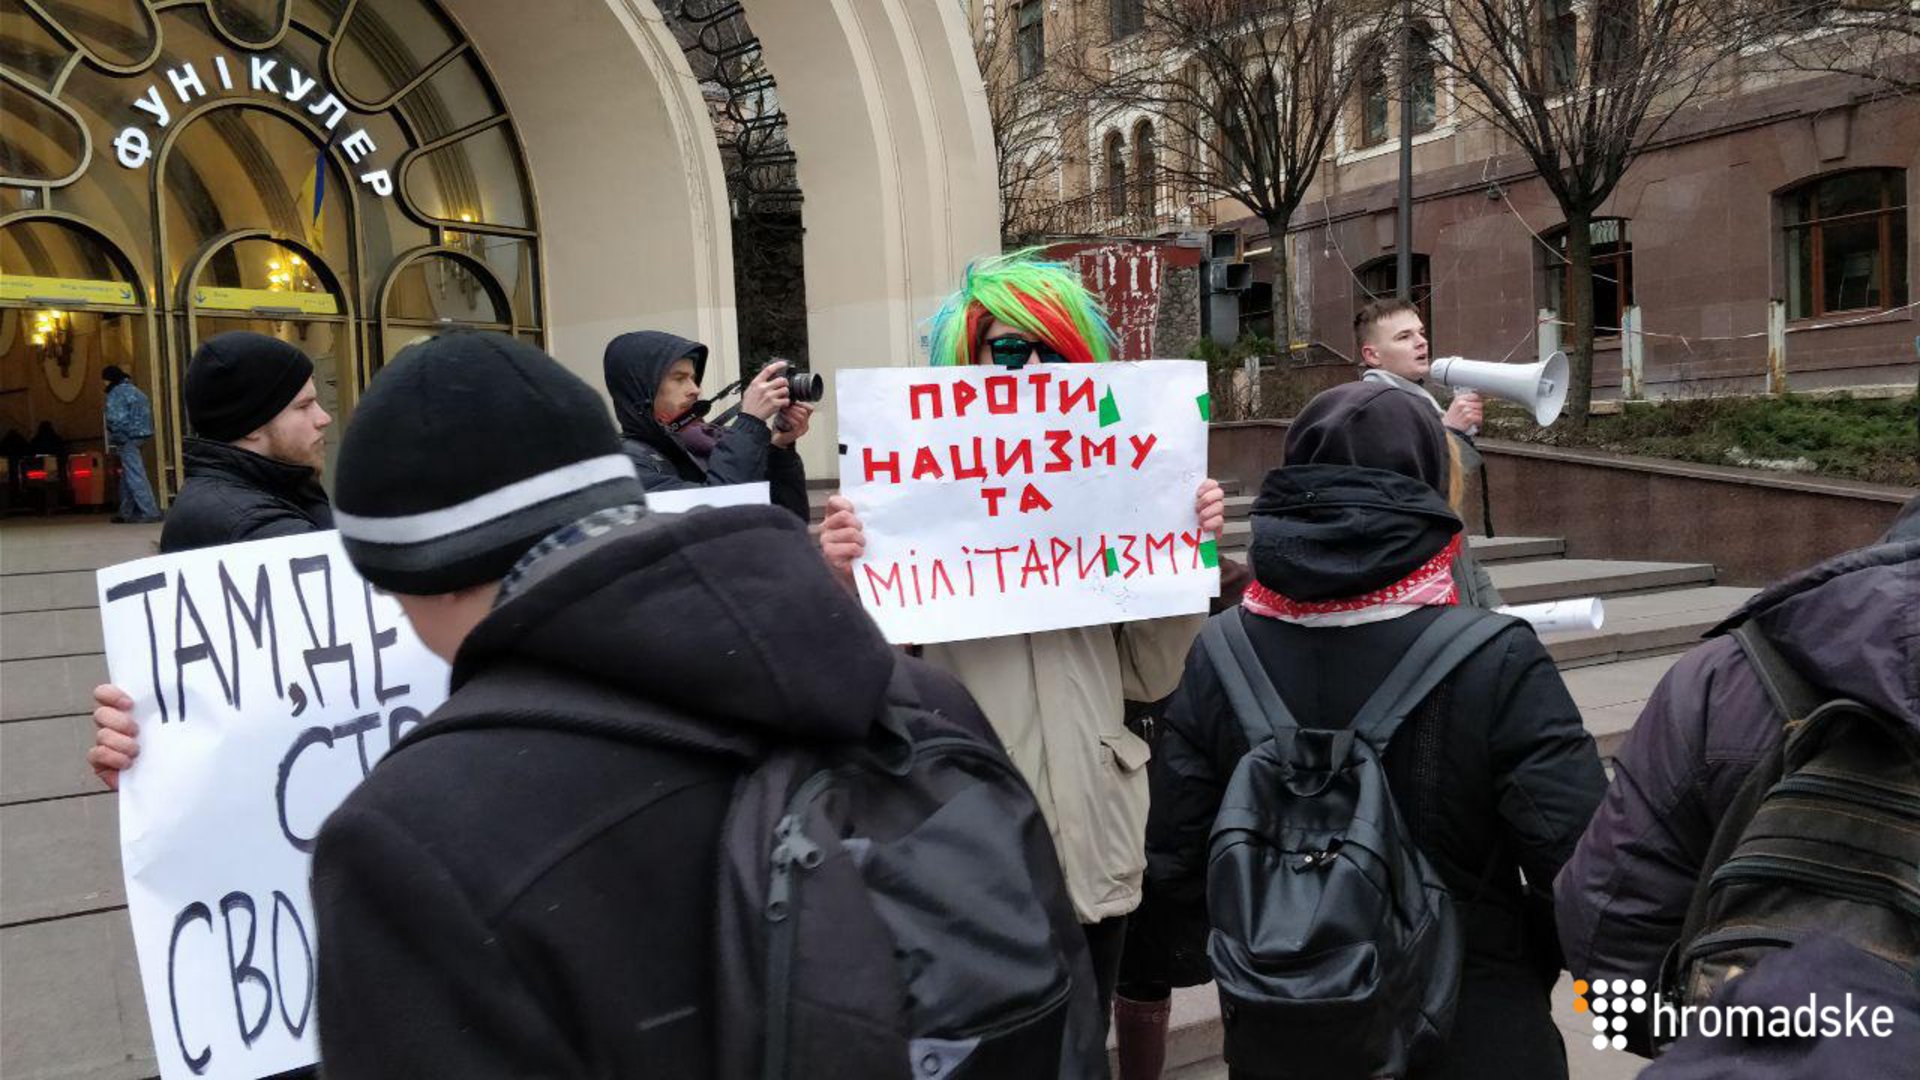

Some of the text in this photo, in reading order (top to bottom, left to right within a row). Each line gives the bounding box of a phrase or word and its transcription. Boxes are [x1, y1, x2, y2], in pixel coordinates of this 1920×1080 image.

[111, 56, 394, 197] ФУНІКУЛЕР
[909, 373, 1096, 420] ПРОТИ
[863, 430, 1158, 484] НАЦИЗМУ
[981, 482, 1053, 517] ТА
